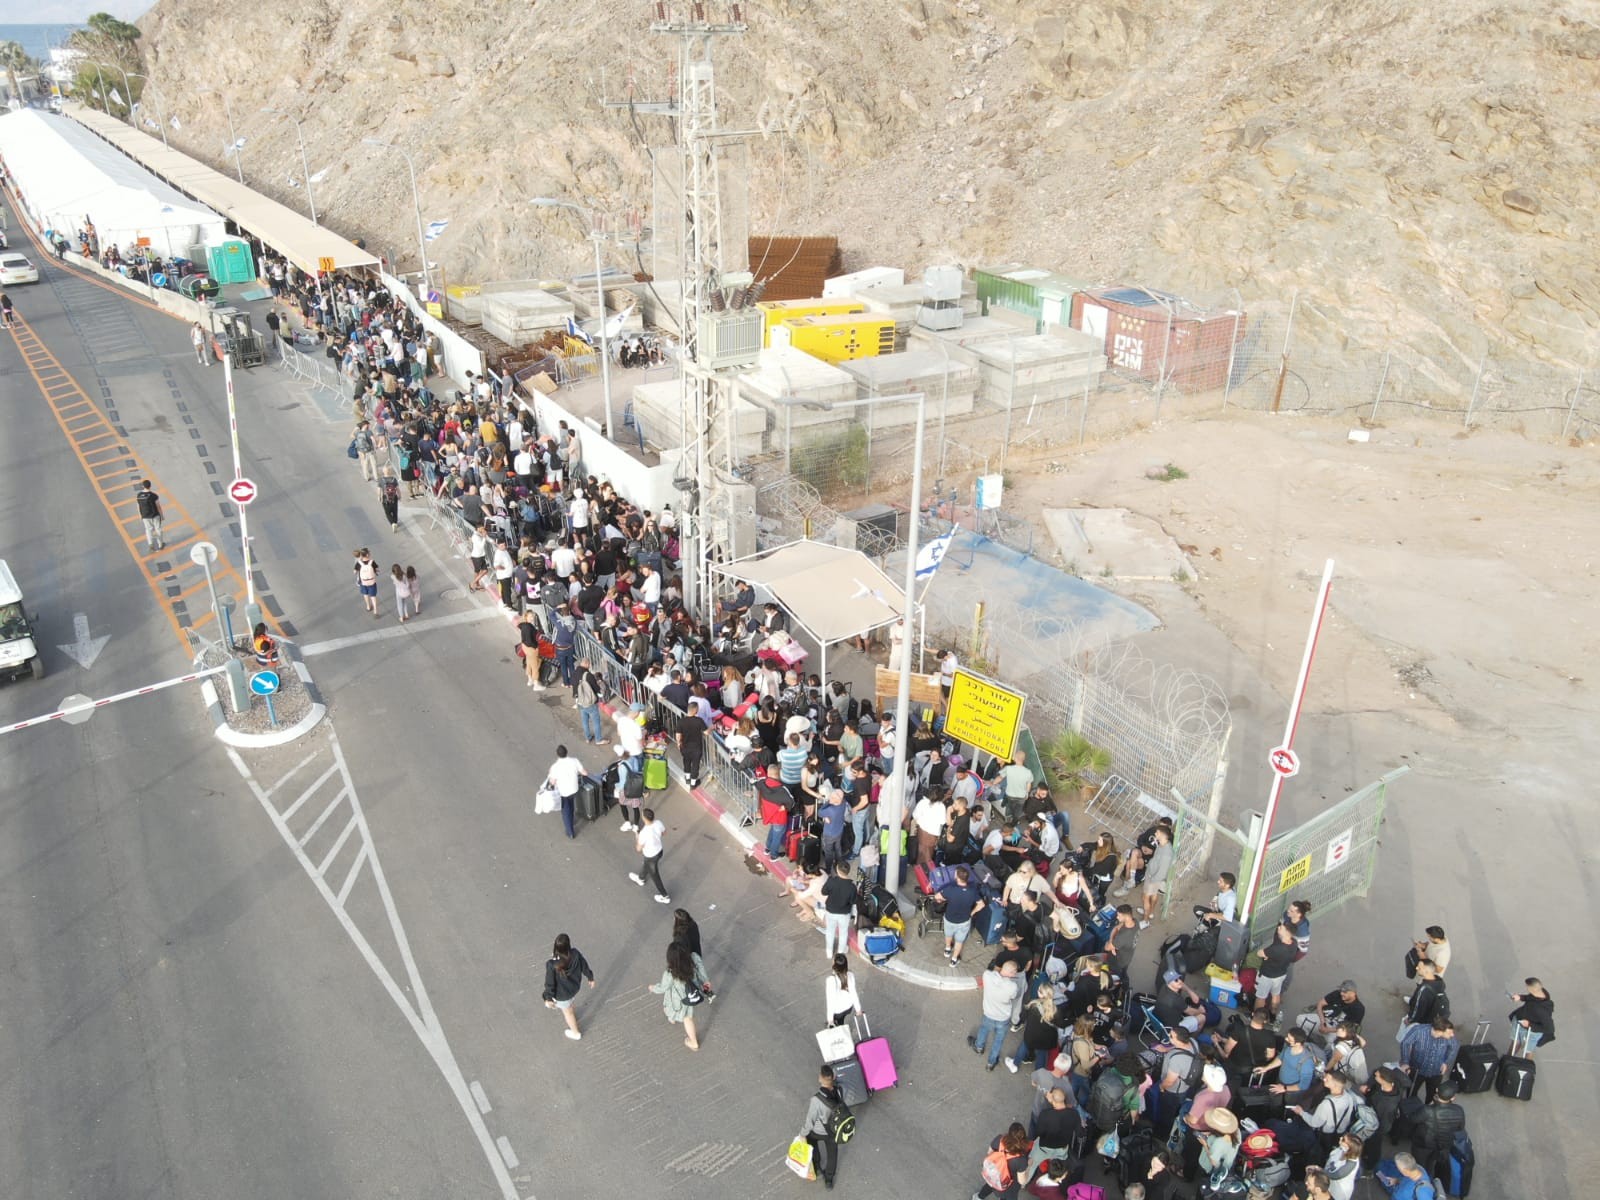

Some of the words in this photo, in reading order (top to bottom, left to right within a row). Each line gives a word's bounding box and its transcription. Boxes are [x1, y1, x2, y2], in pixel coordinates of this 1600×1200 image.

[1113, 349, 1143, 371] ZIM
[966, 680, 984, 691] רכב
[969, 692, 1005, 712] תפעולי
[991, 691, 1012, 703] אזור
[953, 726, 982, 743] VEHICLE
[986, 740, 1005, 753] ZONE
[955, 717, 1007, 745] OPERATIONAL
